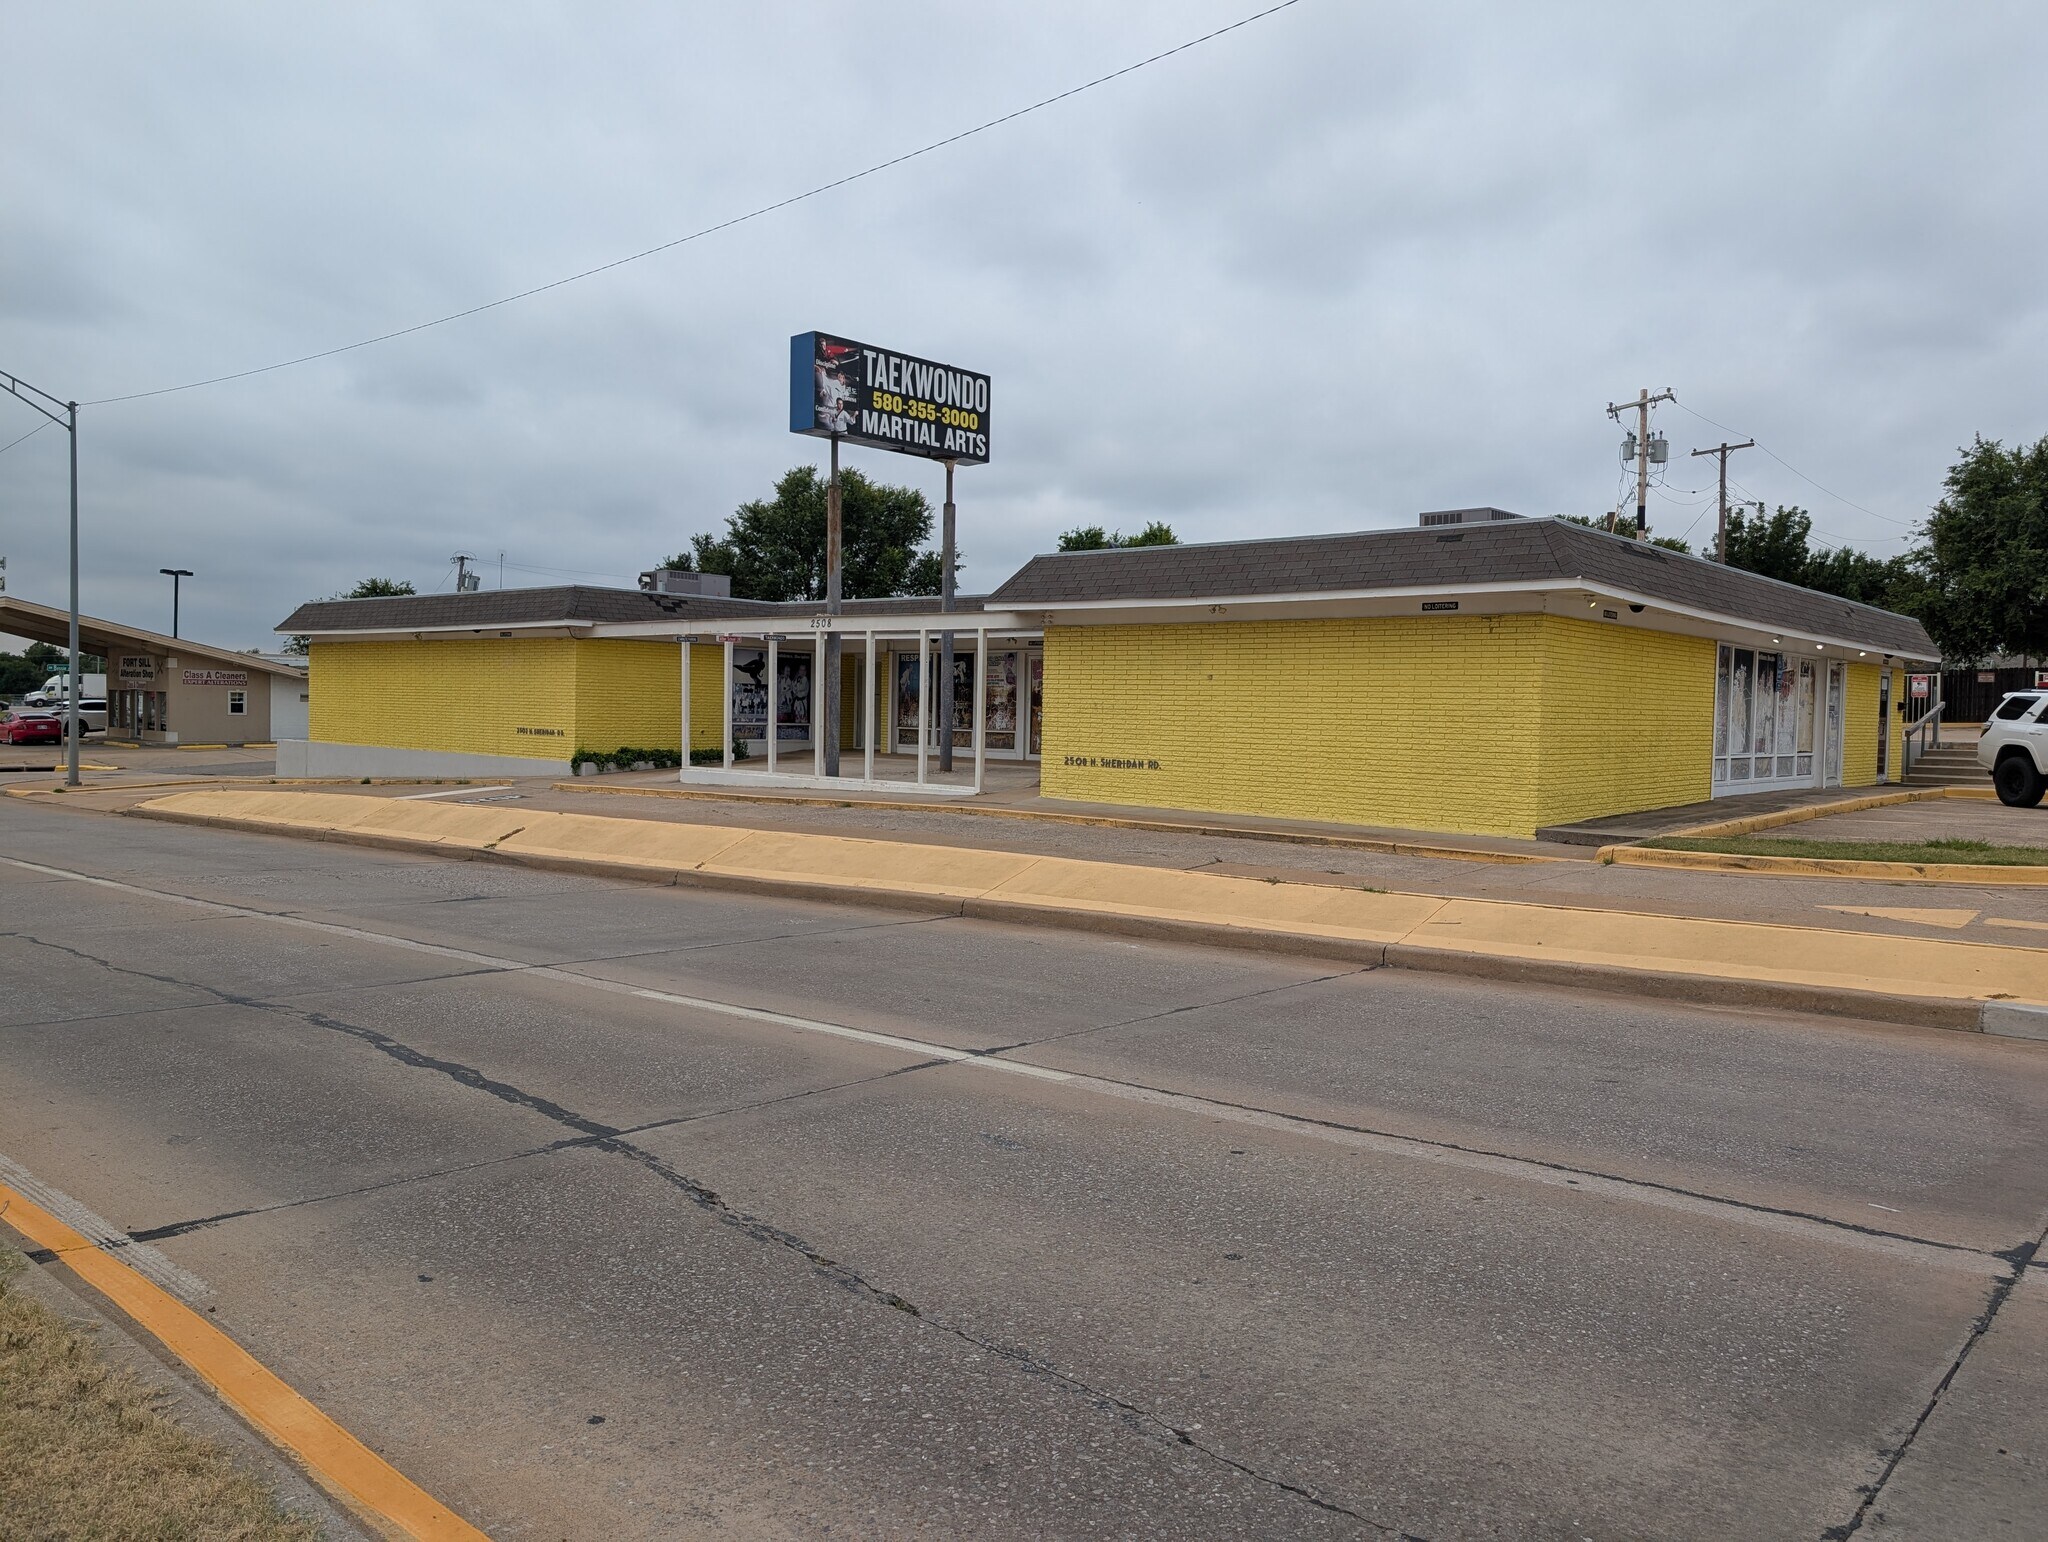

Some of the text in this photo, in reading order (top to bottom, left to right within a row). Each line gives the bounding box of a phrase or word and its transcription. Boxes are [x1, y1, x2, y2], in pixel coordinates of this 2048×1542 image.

[863, 350, 988, 413] TAEKWONDO
[872, 391, 979, 430] 580-355-3000
[862, 409, 986, 457] MARTIAL ARTS
[811, 618, 832, 629] 2508
[122, 657, 152, 668] FORT SILL
[120, 669, 154, 680] Alteration Shop
[184, 670, 247, 680] Class A Cleaners
[1064, 756, 1162, 770] 2508 N. SHERIDAN RD.
